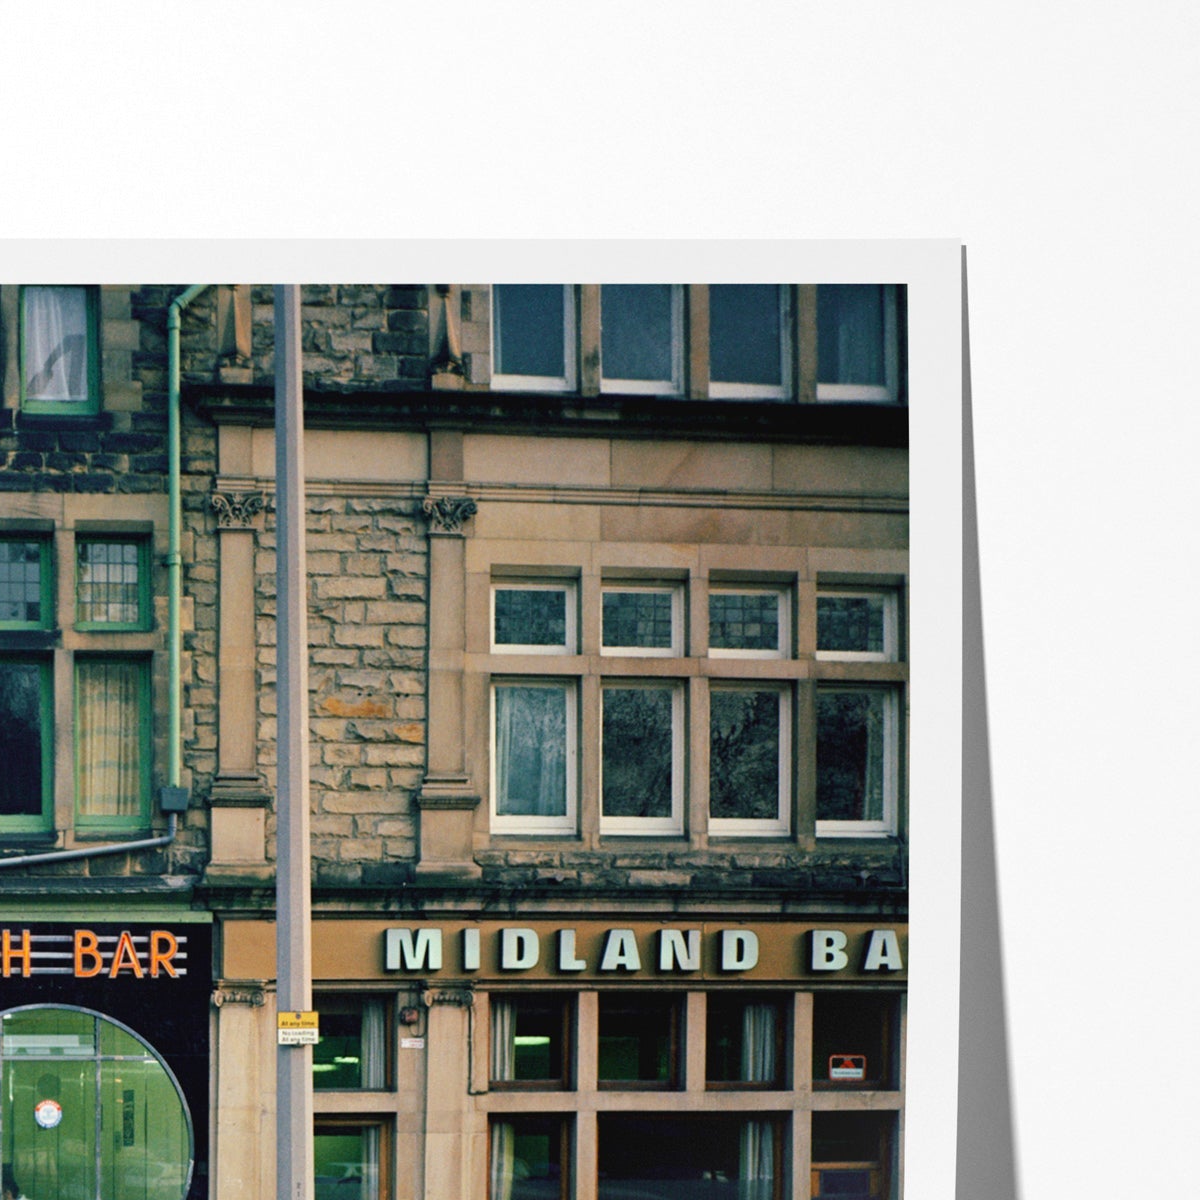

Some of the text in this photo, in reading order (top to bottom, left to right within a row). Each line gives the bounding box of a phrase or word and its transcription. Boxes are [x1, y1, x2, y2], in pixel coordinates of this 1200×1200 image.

[73, 929, 179, 979] BAR
[385, 927, 904, 970] MIDLAND BA
